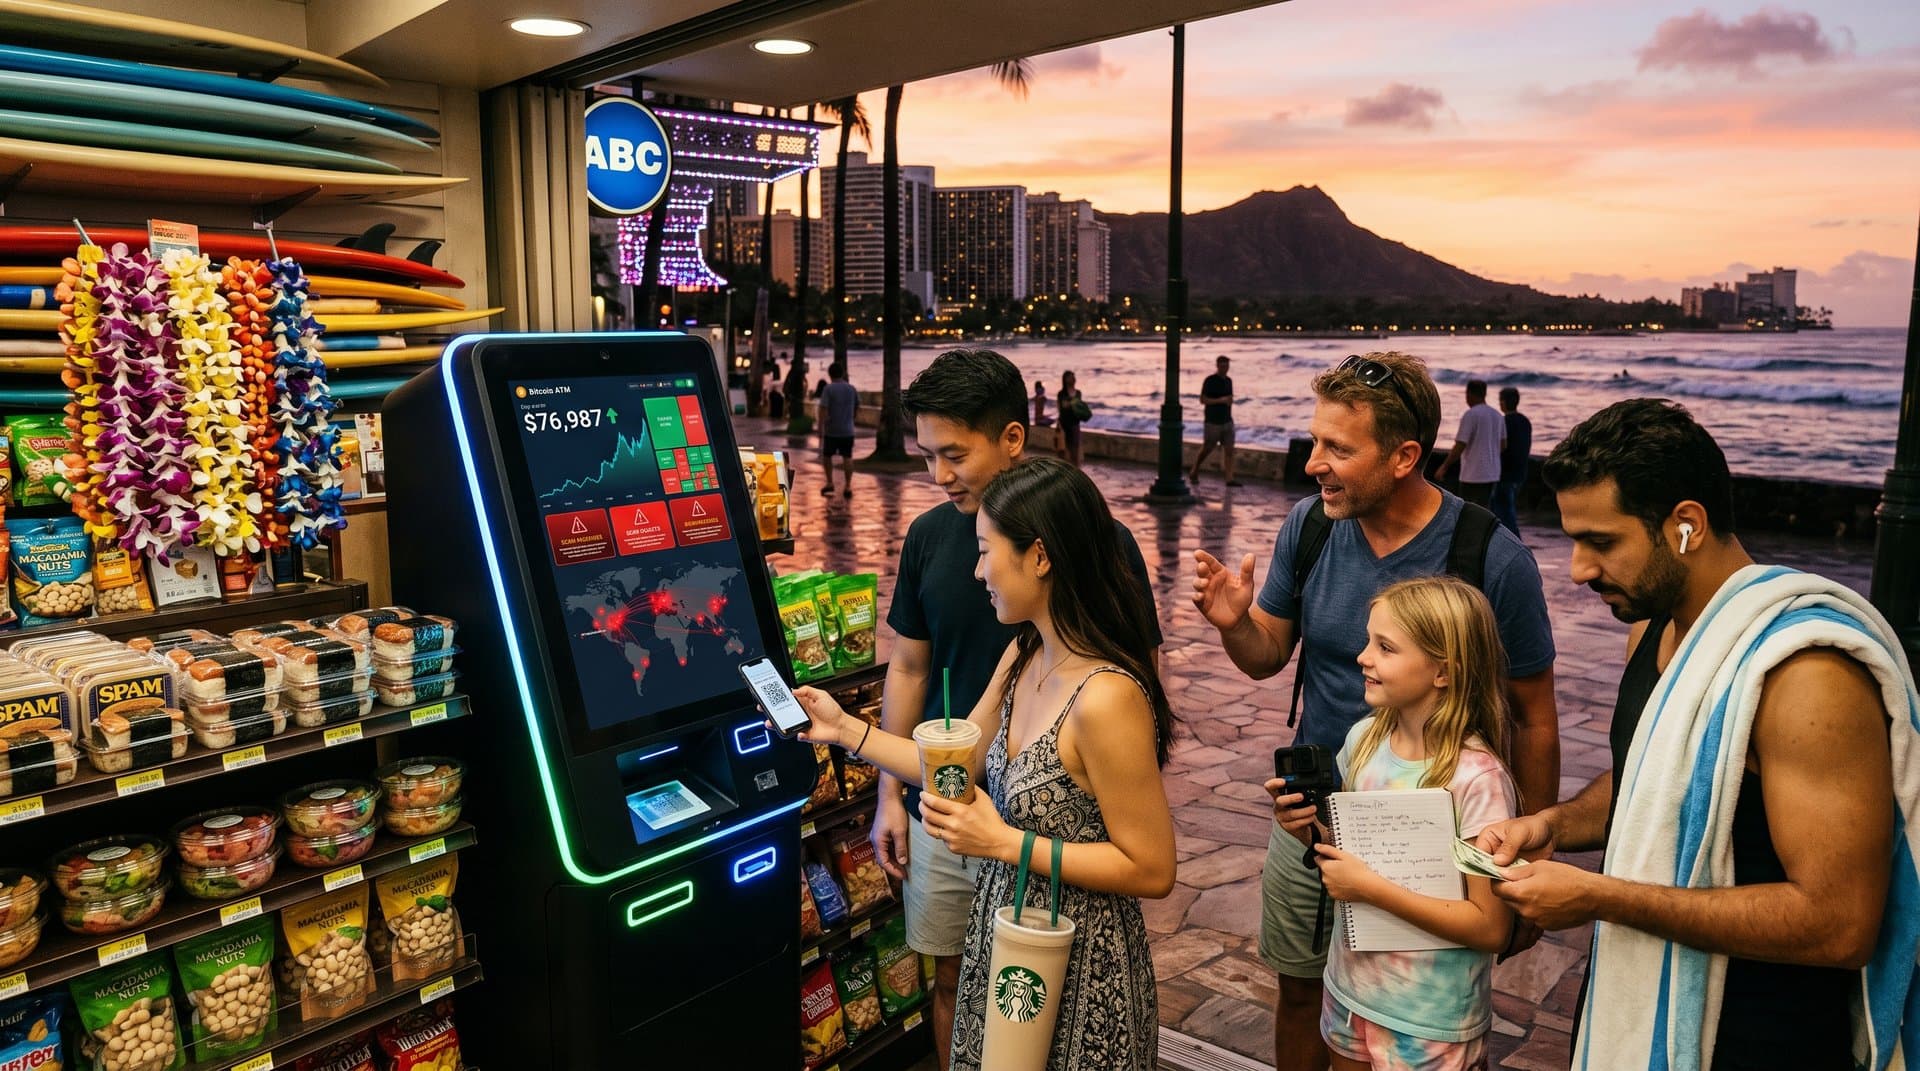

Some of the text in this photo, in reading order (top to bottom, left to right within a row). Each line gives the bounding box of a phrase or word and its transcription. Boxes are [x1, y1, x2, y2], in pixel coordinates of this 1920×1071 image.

[585, 135, 663, 175] ABC
[529, 386, 571, 396] Bitcoin ATM
[524, 409, 601, 434] $76,987
[19, 551, 87, 564] MACADAMIA
[37, 561, 71, 572] NUTS
[99, 677, 164, 703] SPAM
[392, 868, 449, 895] MACADAMIA
[410, 882, 436, 897] NUTS
[297, 900, 360, 929] MACADAMIA
[195, 934, 262, 964] MACADAMIA
[216, 949, 246, 968] NUTS
[95, 965, 165, 1000] MACADAMIA
[118, 981, 150, 1001] NUTS
